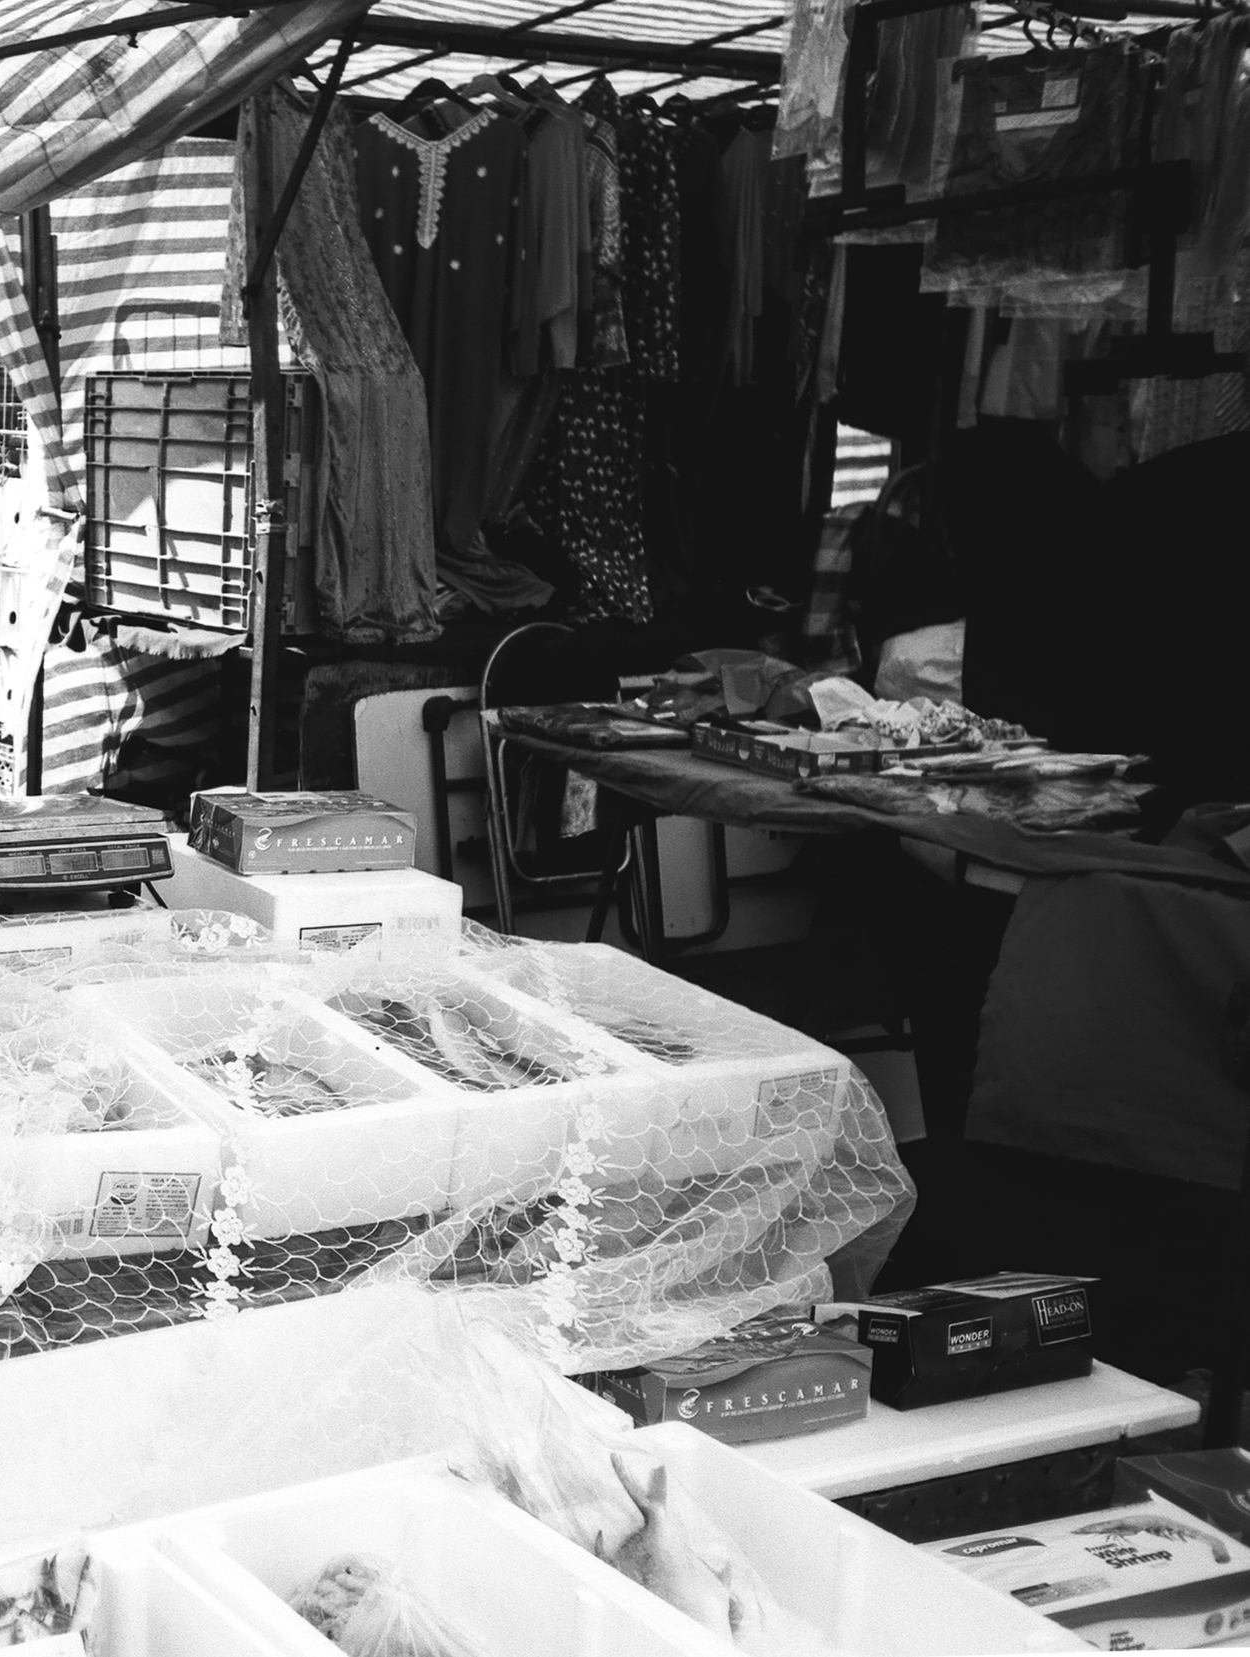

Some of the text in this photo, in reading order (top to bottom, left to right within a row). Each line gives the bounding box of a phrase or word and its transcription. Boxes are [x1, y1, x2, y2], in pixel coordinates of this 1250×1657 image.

[277, 835, 404, 848] FRESCAMAR
[870, 1328, 898, 1336] WONDER
[951, 1329, 990, 1346] WONDER
[706, 1379, 859, 1413] FRESCAMAR
[1105, 1550, 1173, 1569] Shrimp
